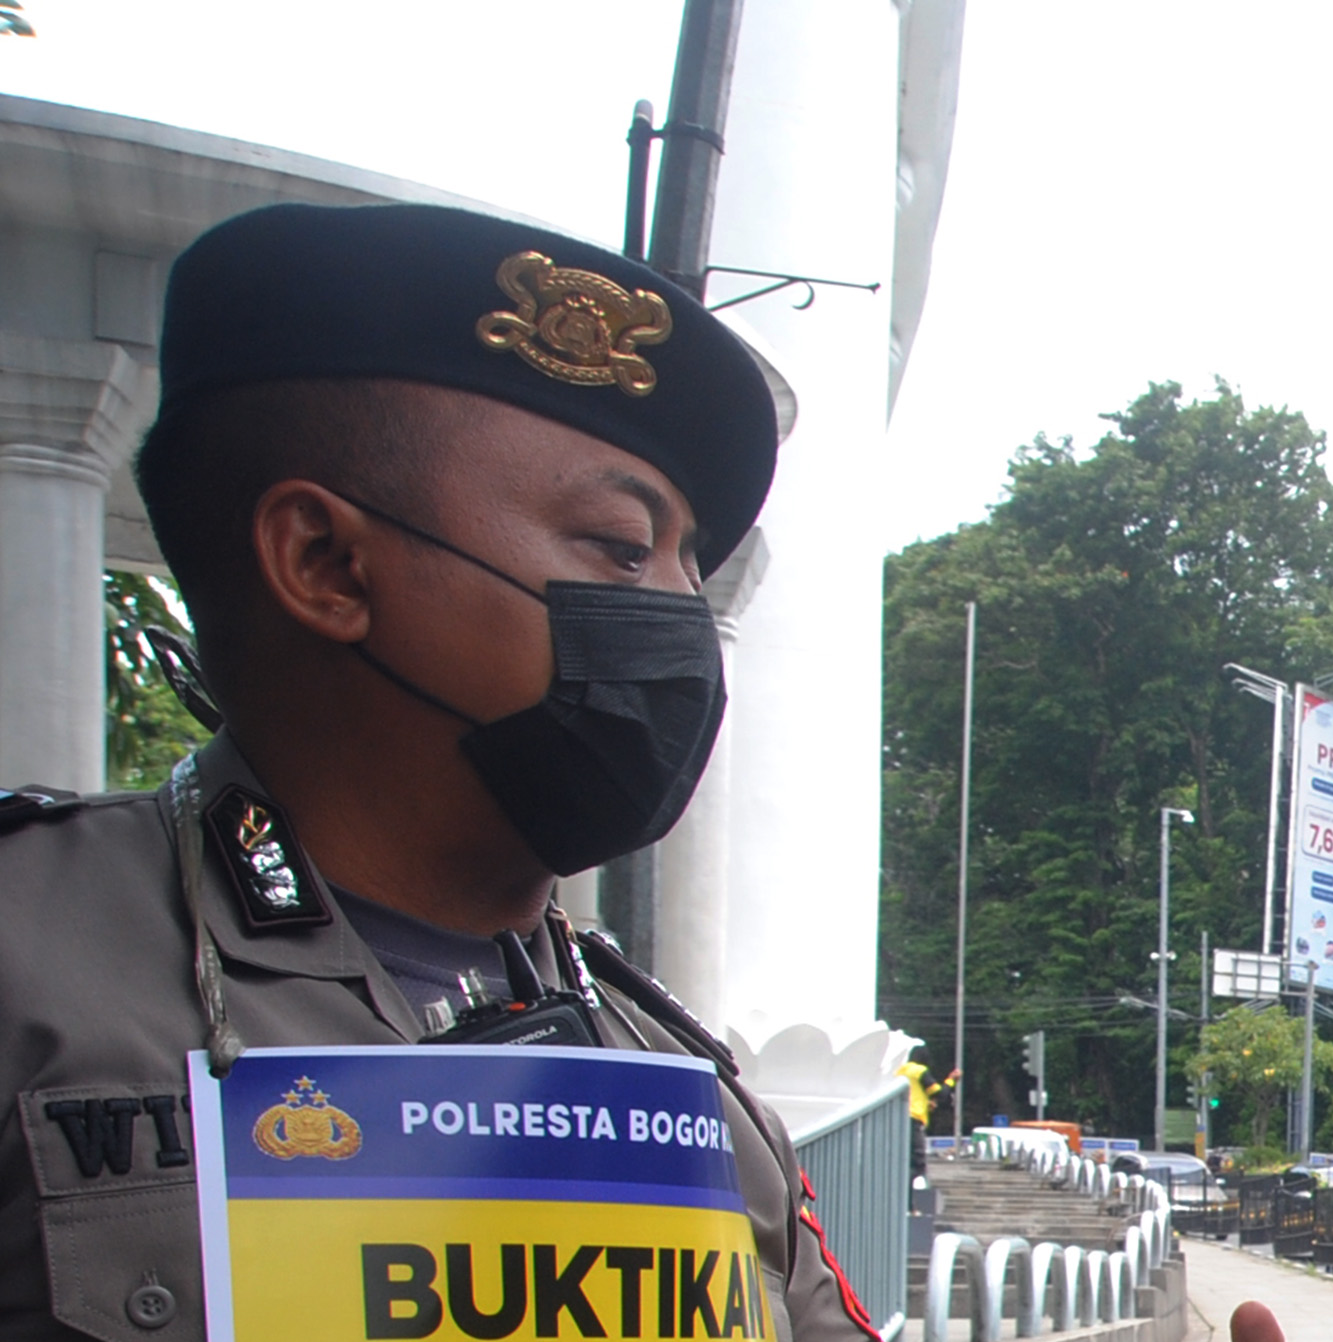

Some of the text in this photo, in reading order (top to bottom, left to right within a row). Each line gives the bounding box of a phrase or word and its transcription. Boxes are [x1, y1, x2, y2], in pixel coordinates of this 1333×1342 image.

[44, 1095, 192, 1178] WI
[401, 1100, 617, 1140] POLRESTA
[628, 1109, 719, 1150] BOGOR
[360, 1243, 766, 1341] BUKTIKAN
